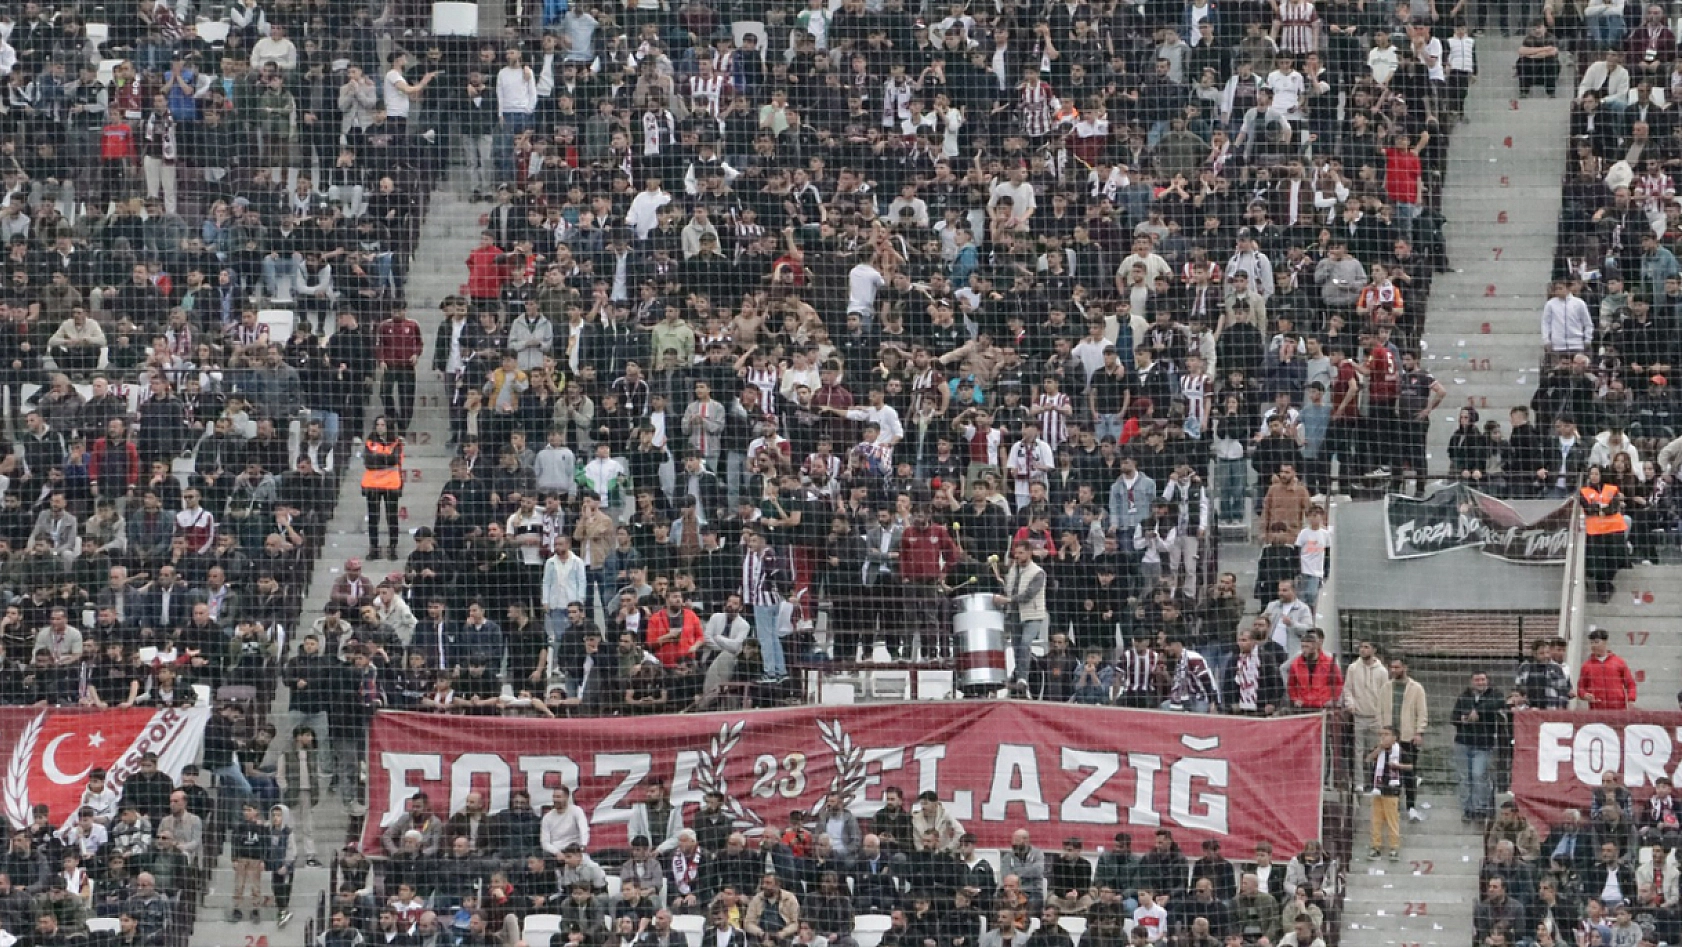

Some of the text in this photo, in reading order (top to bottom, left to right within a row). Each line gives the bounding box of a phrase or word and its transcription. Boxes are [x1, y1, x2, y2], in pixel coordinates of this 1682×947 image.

[1497, 210, 1508, 224] 6
[1492, 247, 1503, 261] 7
[1468, 358, 1490, 371] 10
[420, 395, 438, 407] 11
[1467, 396, 1487, 408] 11
[408, 432, 431, 445] 12
[1395, 519, 1453, 552] FORZA
[1631, 589, 1655, 604] 16
[1626, 631, 1650, 646] 17
[380, 733, 1230, 835] FORZA 23 ELAZIĞ
[1403, 902, 1427, 916] 23
